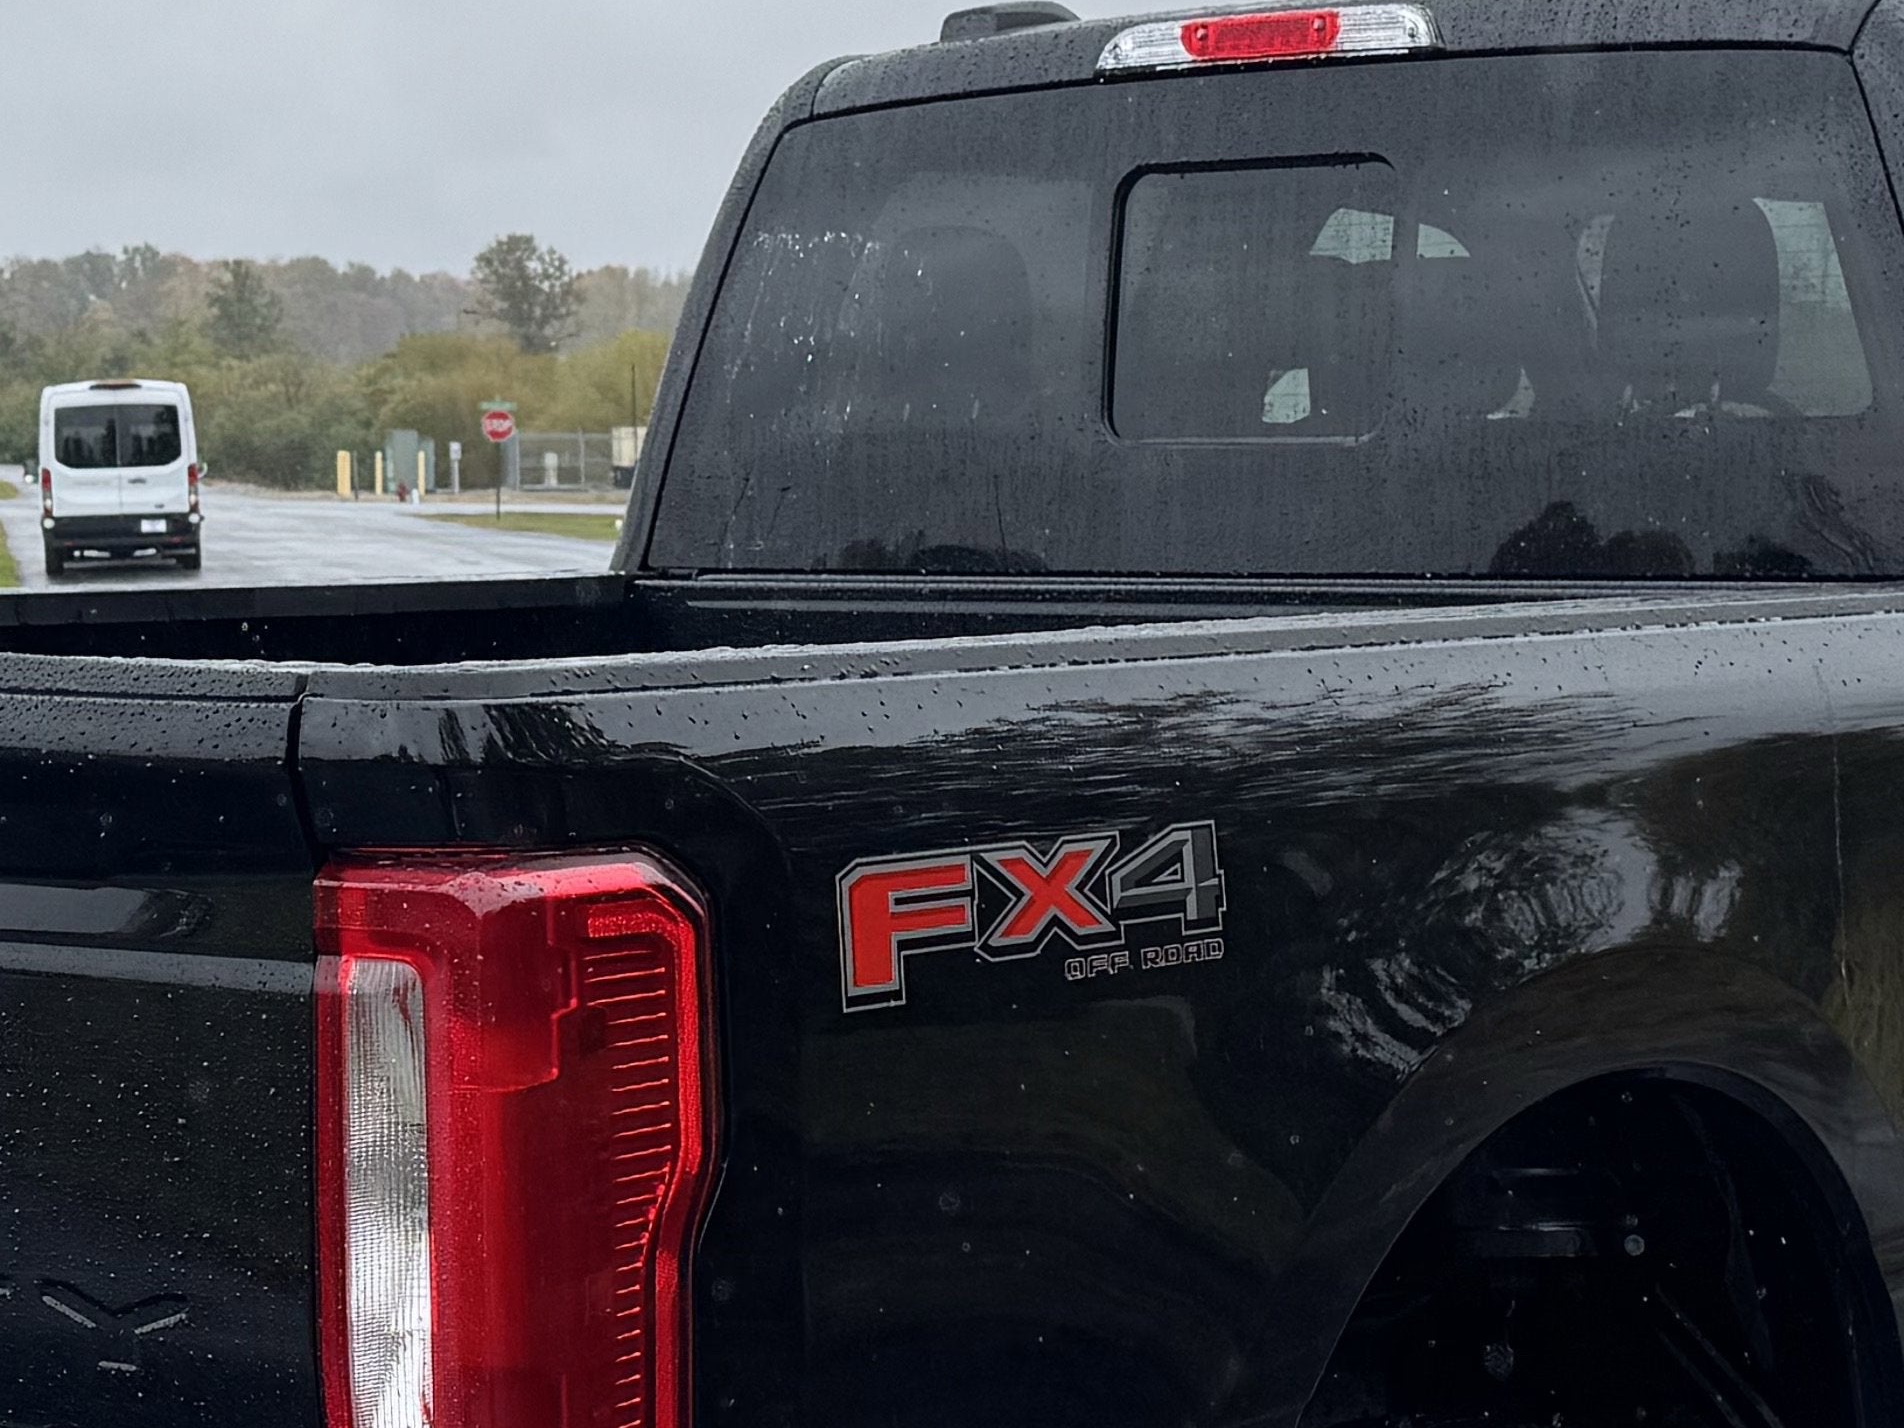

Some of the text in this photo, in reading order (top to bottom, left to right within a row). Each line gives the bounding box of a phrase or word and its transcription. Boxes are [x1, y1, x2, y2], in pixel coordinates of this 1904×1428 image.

[835, 820, 1226, 1013] FX4
[1064, 938, 1225, 980] OFF ROAD
